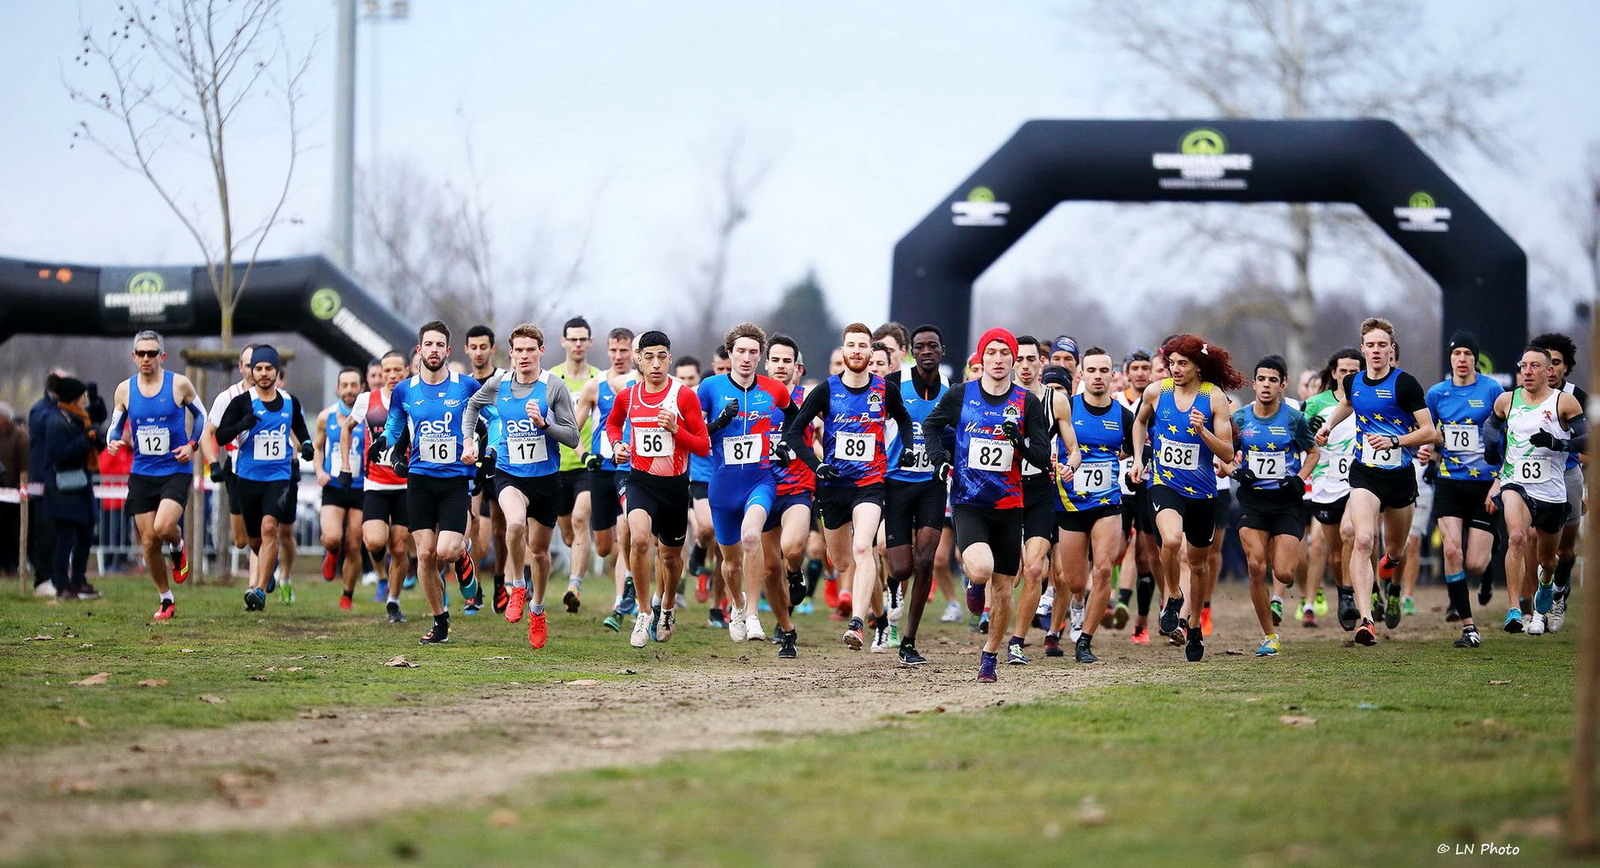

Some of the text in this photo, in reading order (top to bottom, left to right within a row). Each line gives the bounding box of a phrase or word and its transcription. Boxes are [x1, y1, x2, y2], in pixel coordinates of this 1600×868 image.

[145, 437, 162, 451] 12
[643, 435, 662, 453] 56
[1452, 431, 1469, 447] 78
[263, 441, 279, 456] 15
[429, 443, 448, 459] 16
[517, 443, 536, 460] 17
[734, 441, 753, 460] 87
[845, 439, 866, 457] 89
[980, 446, 1003, 466] 82
[1164, 446, 1193, 466] 638
[914, 451, 930, 468] 19
[1256, 458, 1276, 475] 72
[1083, 469, 1103, 486] 79
[1522, 462, 1541, 479] 63
